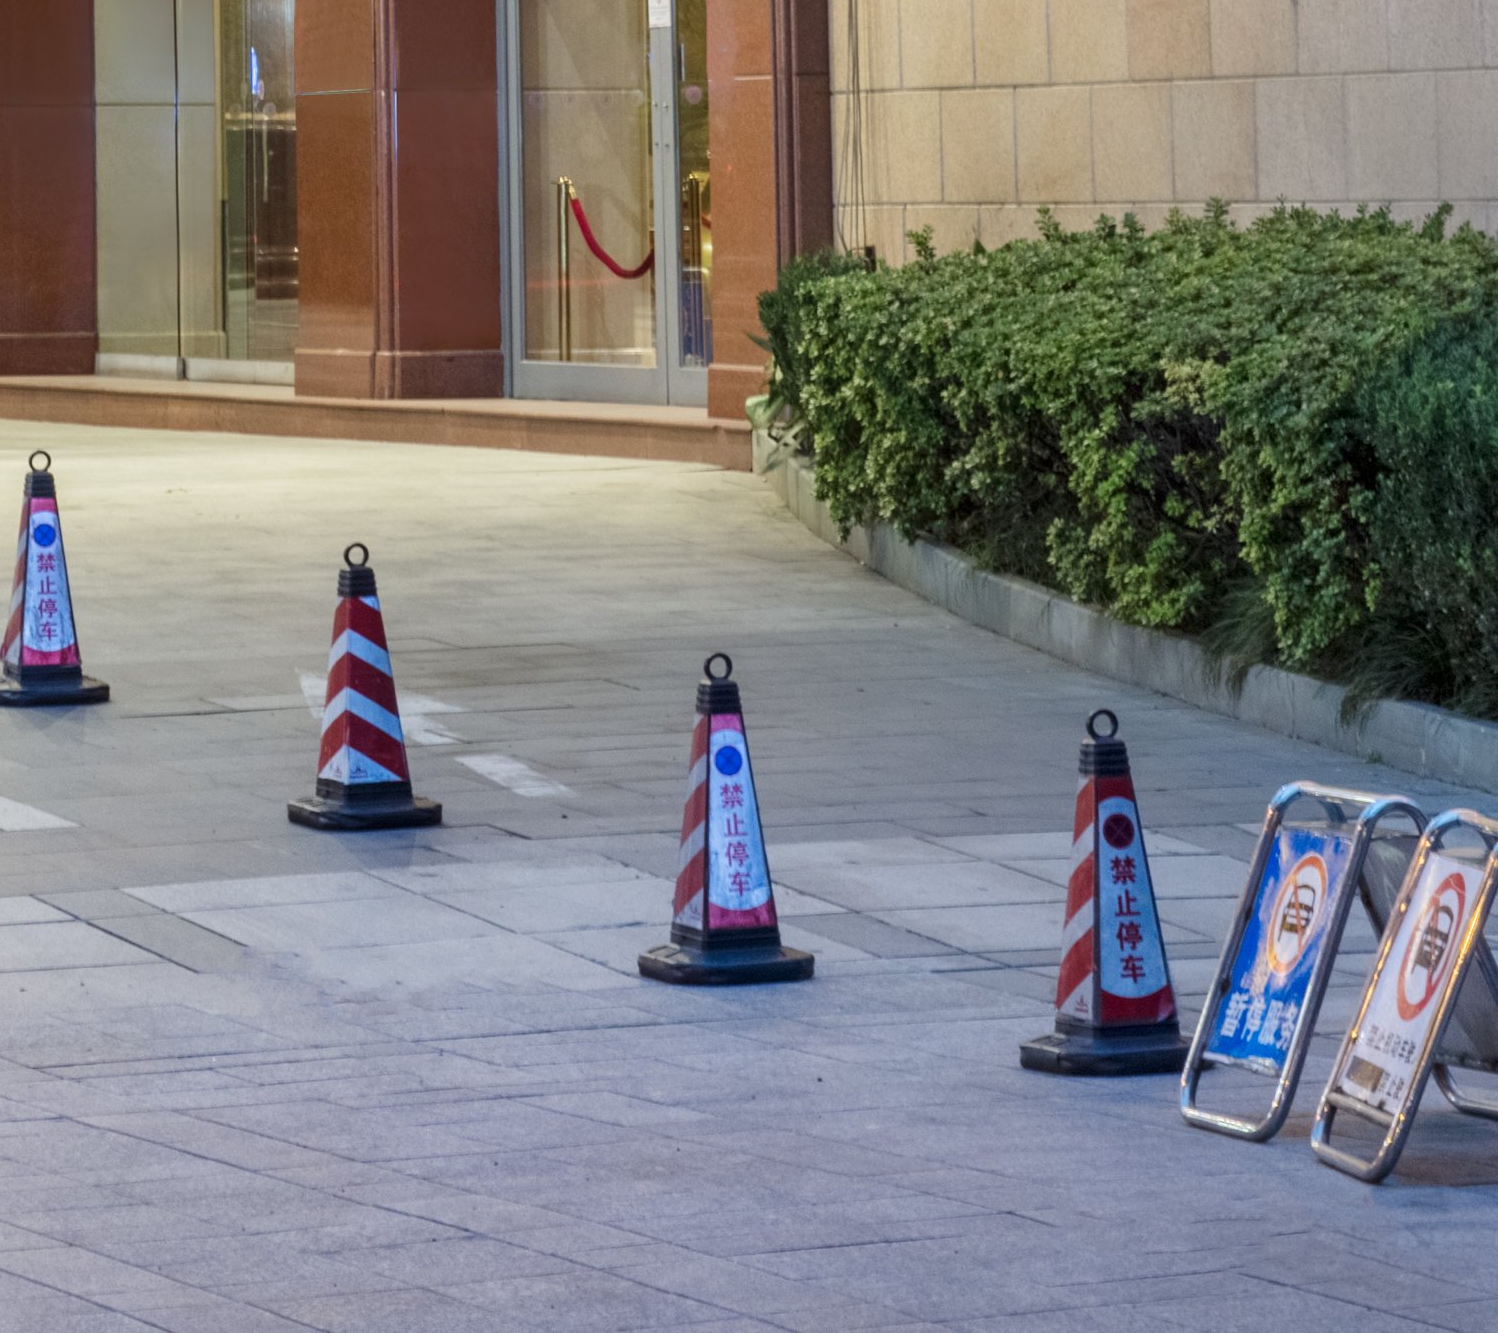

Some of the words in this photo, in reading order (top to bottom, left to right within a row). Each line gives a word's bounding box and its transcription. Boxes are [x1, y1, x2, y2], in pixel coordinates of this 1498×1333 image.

[36, 552, 59, 642] 禁止停车
[719, 782, 752, 898] 禁止停车
[1110, 854, 1146, 984] 禁止停车
